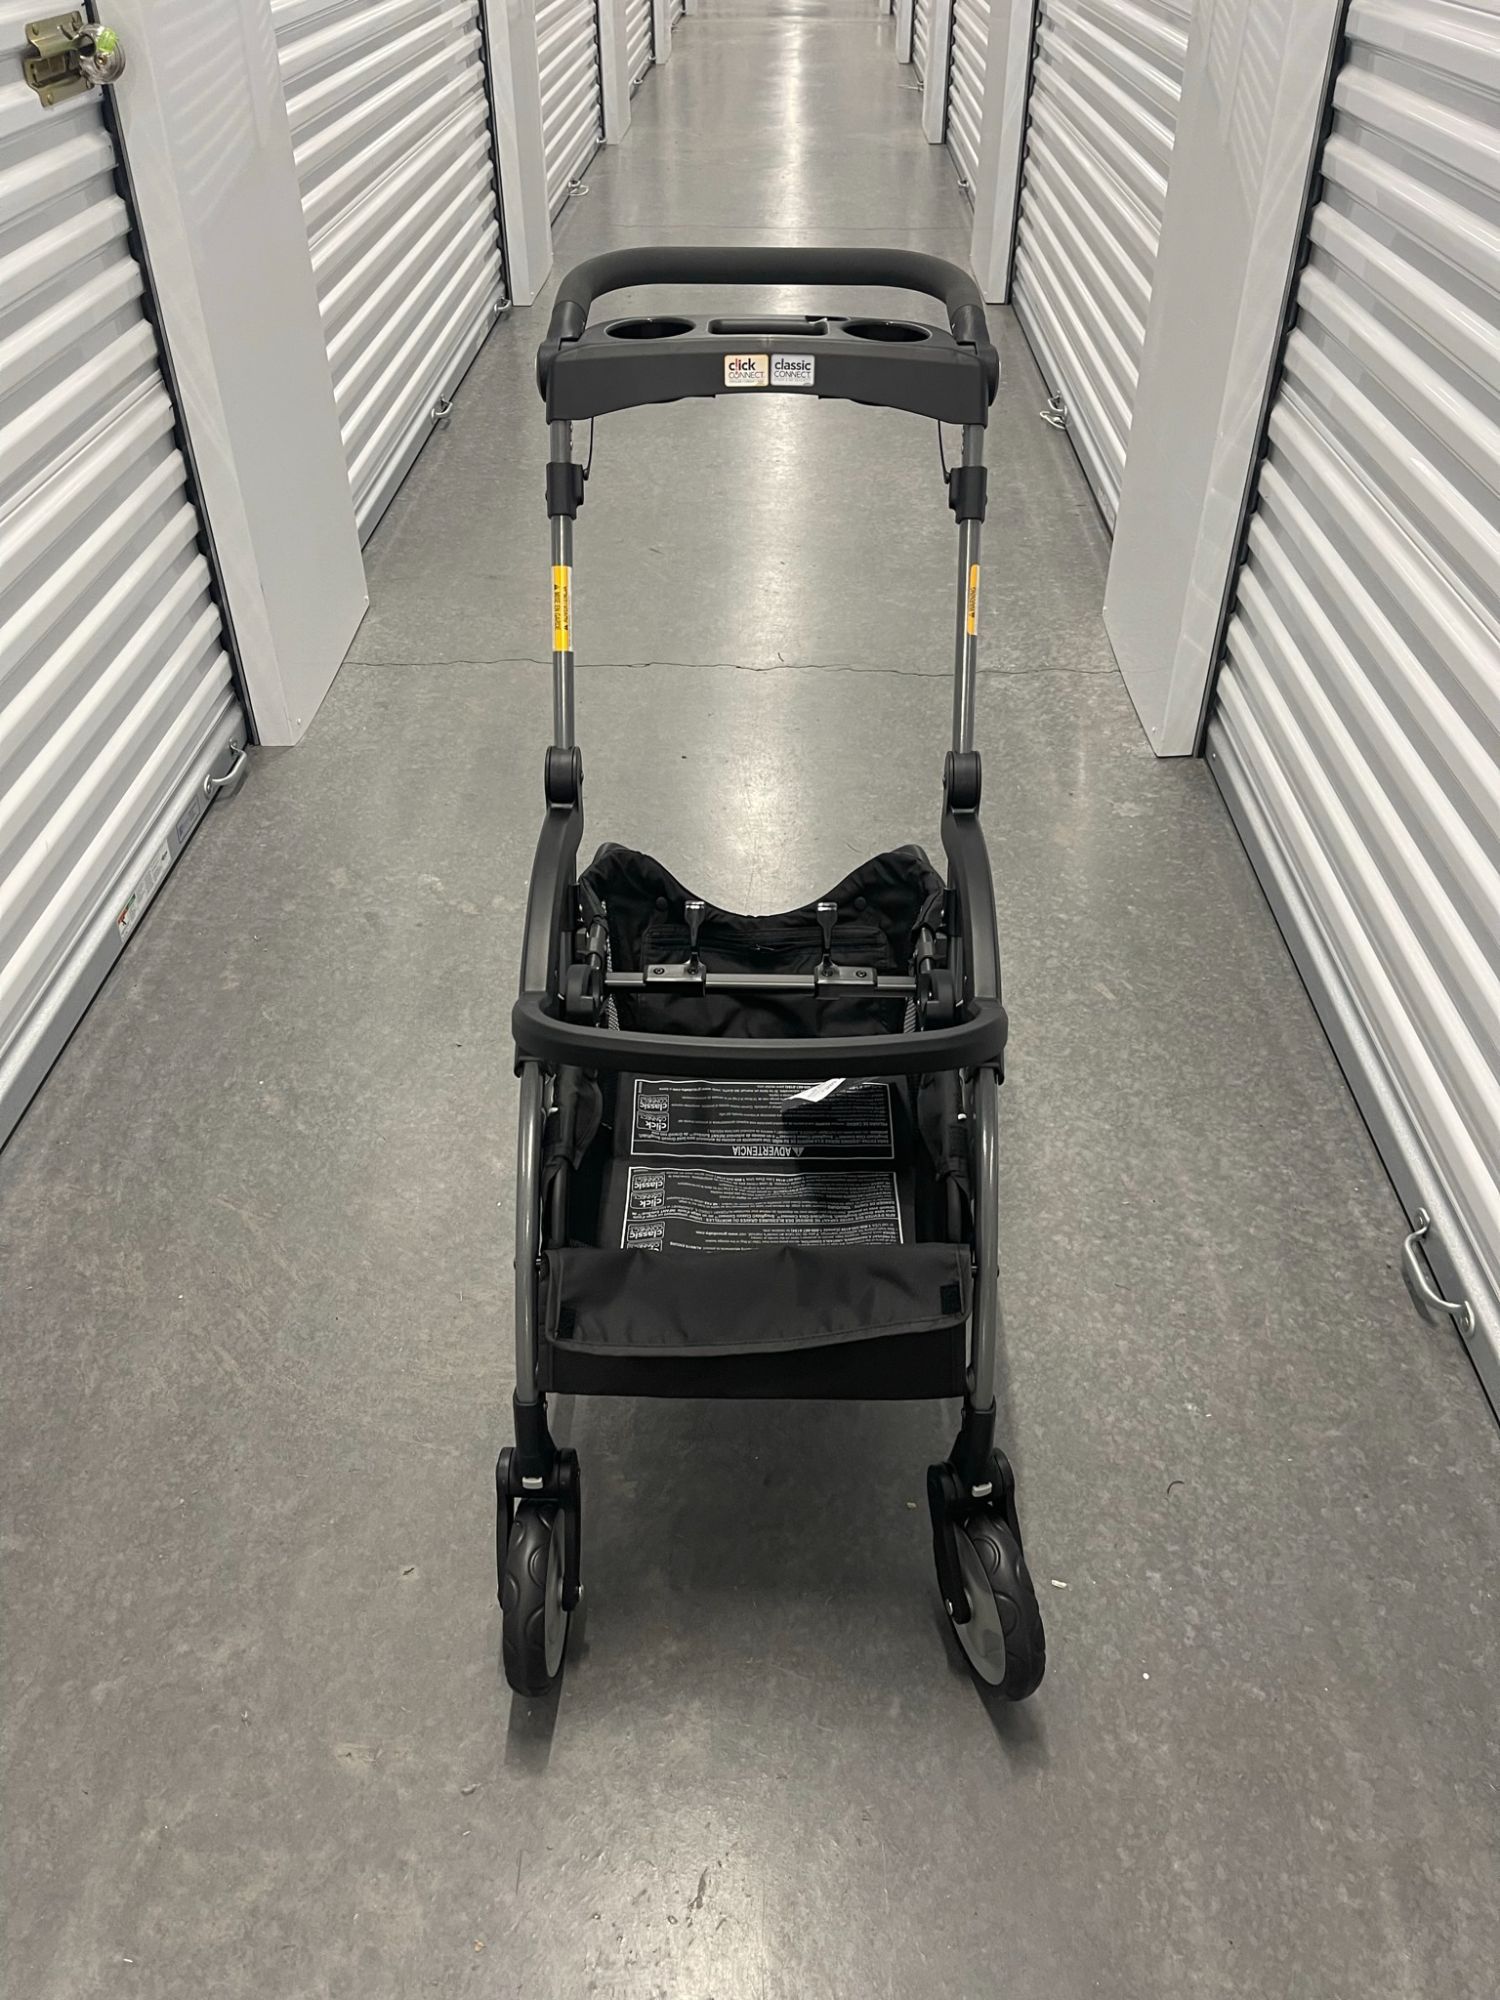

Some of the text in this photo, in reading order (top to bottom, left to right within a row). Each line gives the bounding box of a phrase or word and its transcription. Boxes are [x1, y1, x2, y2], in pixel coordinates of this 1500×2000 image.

[728, 358, 756, 371] click
[775, 358, 811, 371] classic
[728, 371, 764, 379] CONNECT
[774, 371, 811, 379] CONNECT
[639, 1103, 668, 1111] classic
[645, 1121, 667, 1131] click
[731, 1145, 792, 1157] ADVERTENCIA
[634, 1181, 663, 1189] classic
[639, 1198, 662, 1208] click
[629, 1230, 663, 1239] classic
